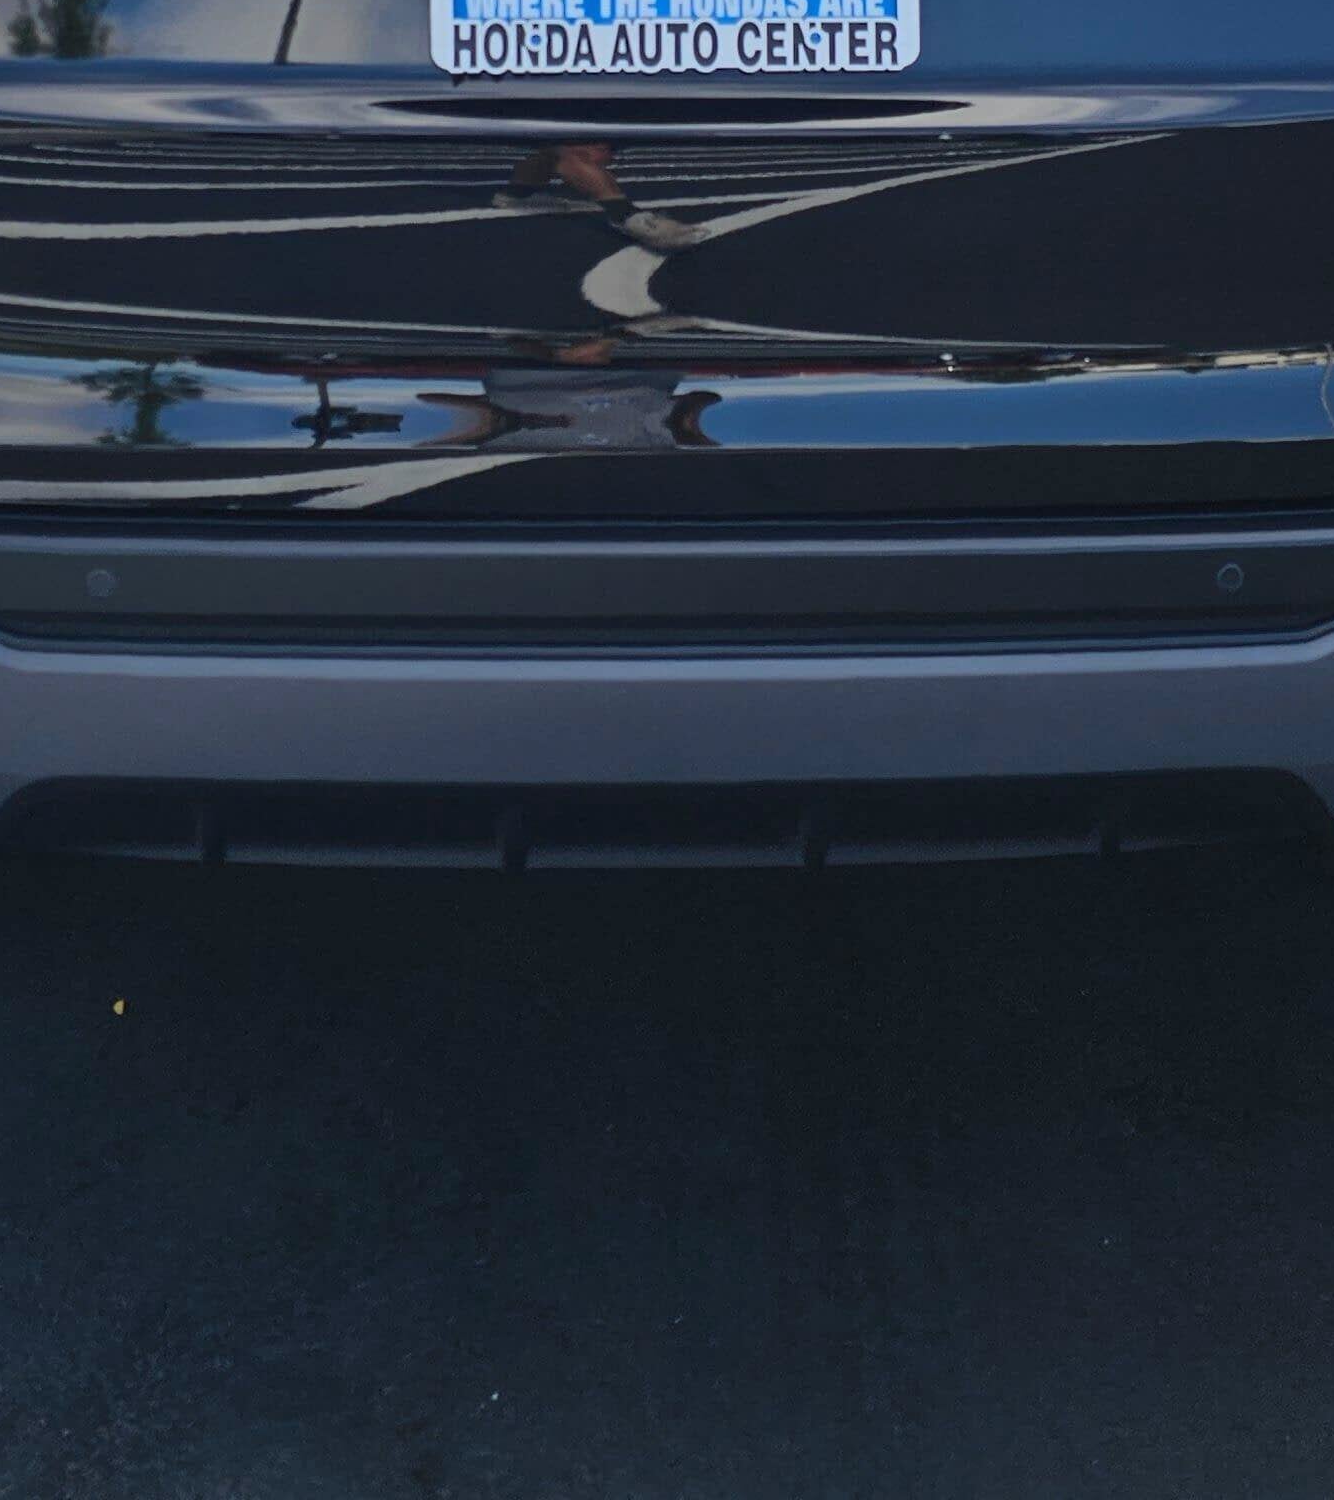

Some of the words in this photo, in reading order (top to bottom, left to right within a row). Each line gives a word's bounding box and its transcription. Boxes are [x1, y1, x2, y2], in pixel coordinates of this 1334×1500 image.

[453, 23, 596, 67] HONDA
[610, 23, 718, 67] AUTO
[736, 21, 898, 67] CENTER
